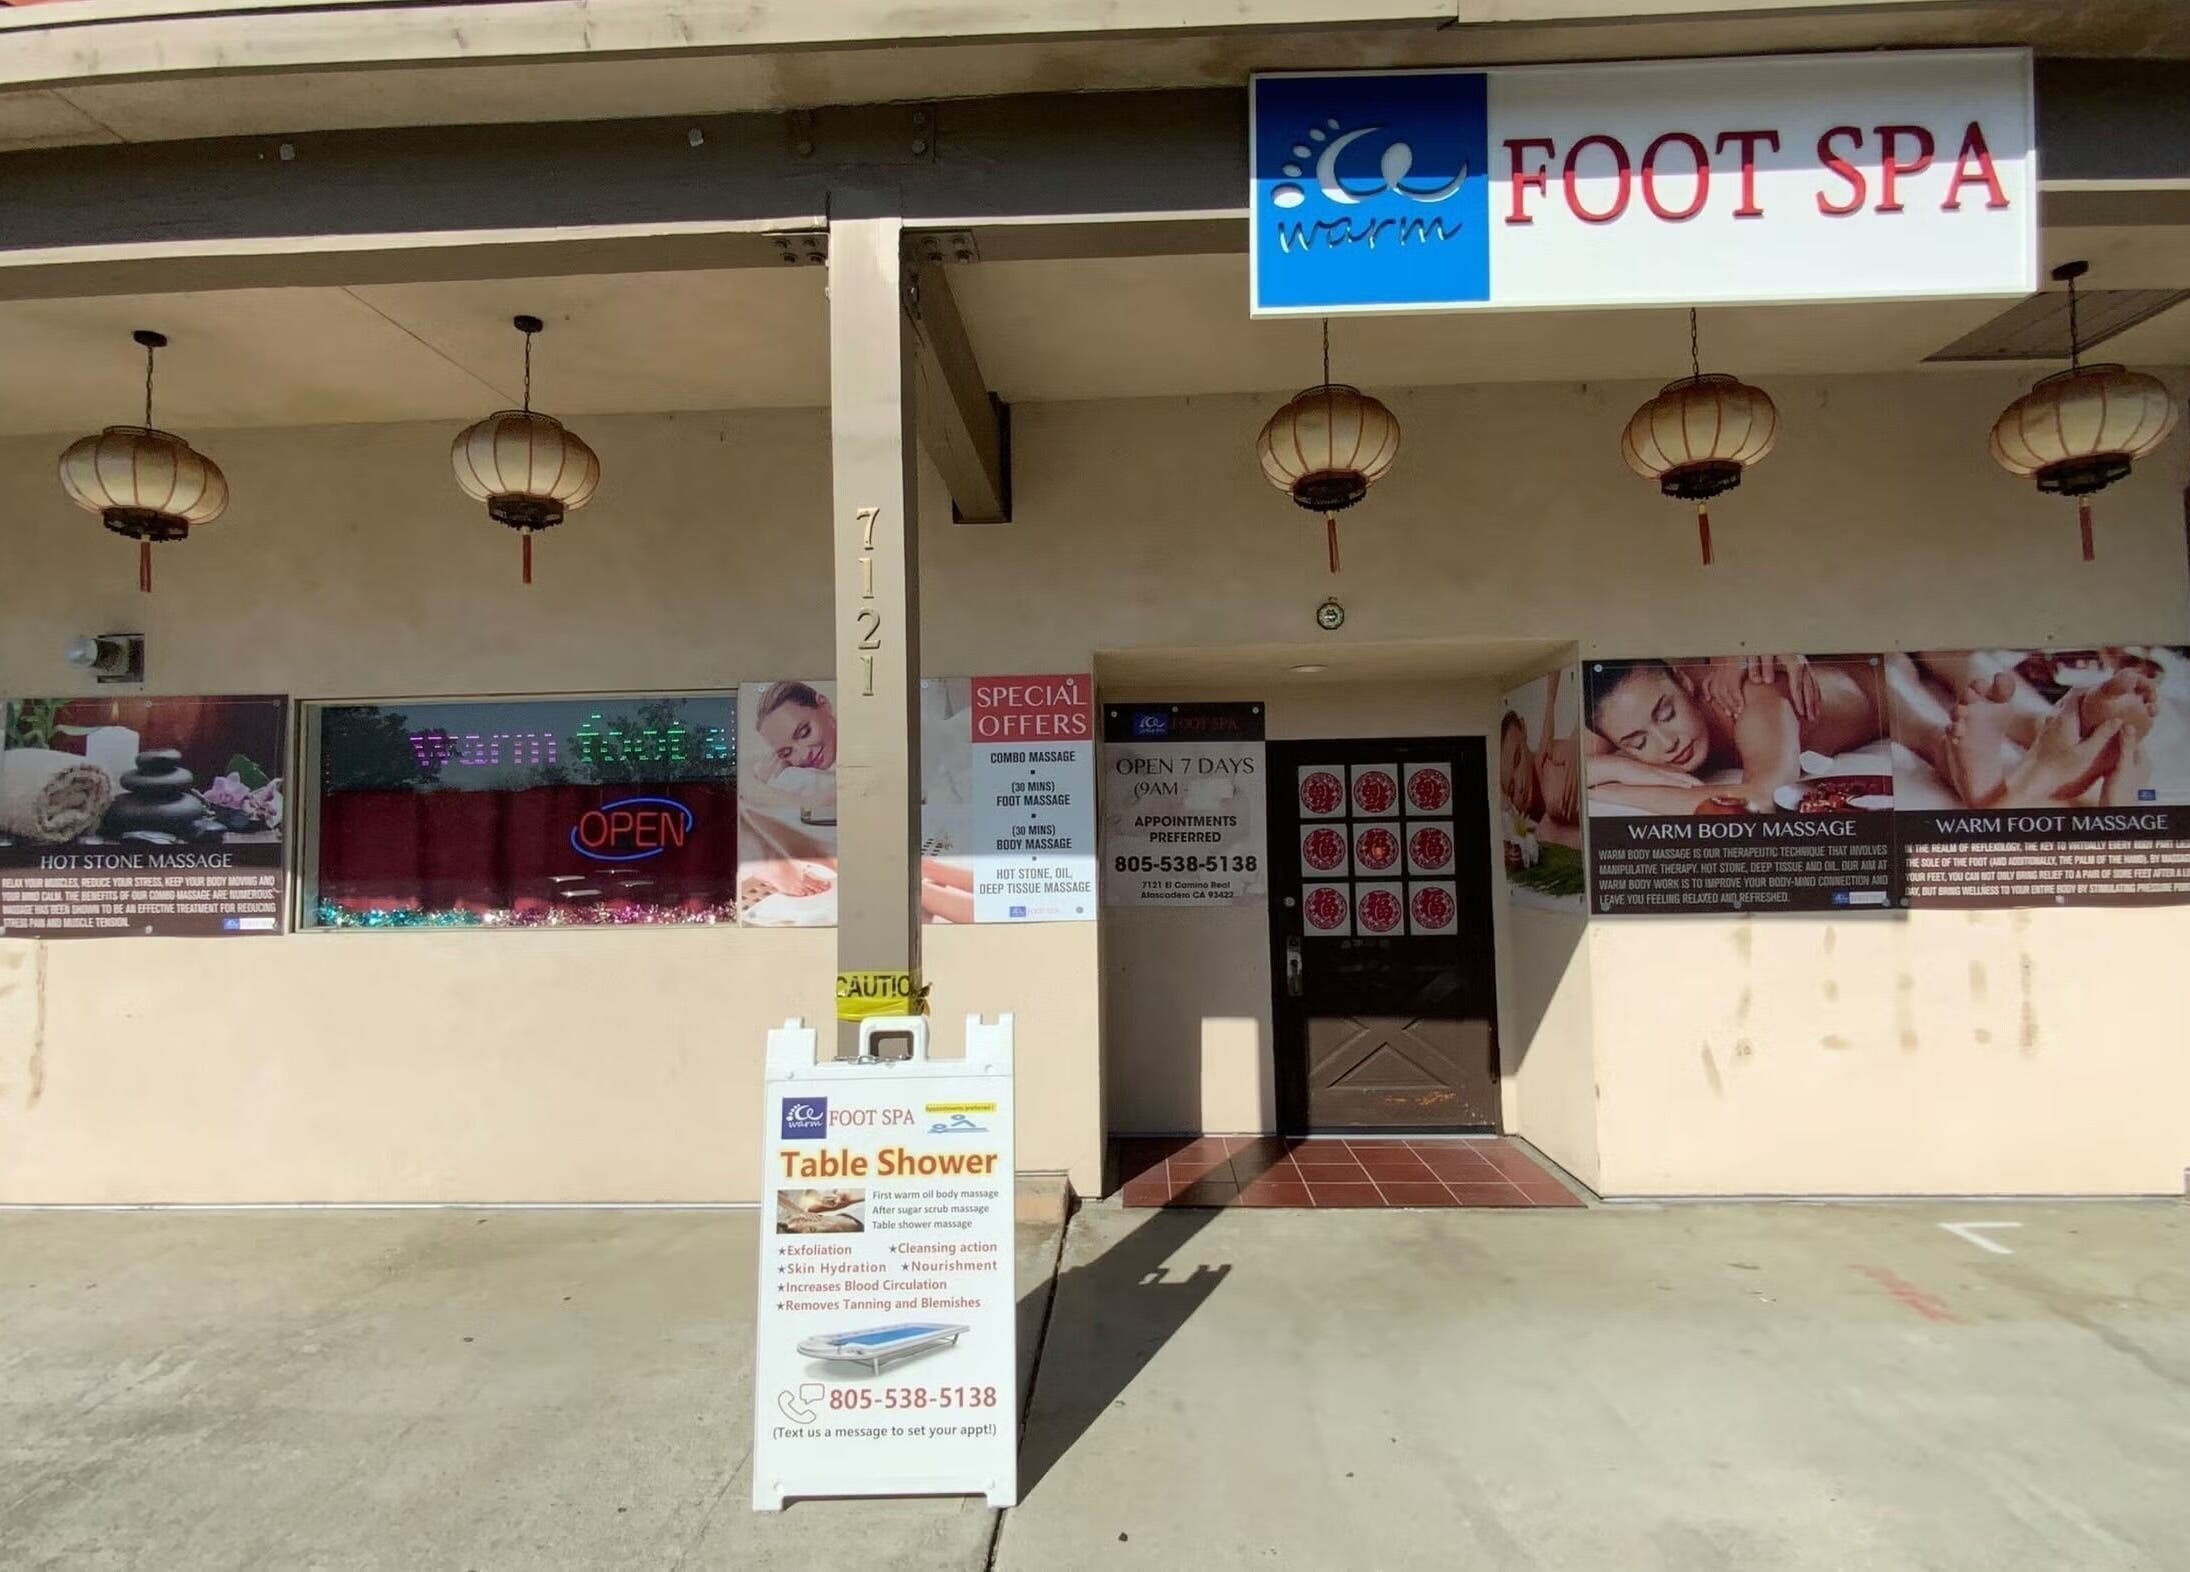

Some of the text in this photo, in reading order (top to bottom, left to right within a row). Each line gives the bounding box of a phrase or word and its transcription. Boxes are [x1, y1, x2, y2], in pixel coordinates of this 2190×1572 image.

[1503, 120, 2010, 225] FOOT SPA
[1278, 215, 1466, 254] warm
[855, 506, 882, 697] 7121
[976, 684, 1087, 708] SPECIAL
[978, 713, 1086, 737] OFFERS
[410, 734, 557, 767] warm
[577, 715, 686, 763] foot
[990, 751, 1076, 764] COMBO MASSAGE
[1116, 757, 1255, 775] OPEN 7 DAYS
[1011, 781, 1056, 793] (30 MINS)
[1134, 781, 1179, 798] (9AM
[996, 794, 1071, 807] FOOT MASSAGE
[1134, 815, 1238, 827] APPOINTMENTS
[1936, 815, 2169, 834] WARM FOOT MASSAGE
[579, 810, 685, 848] OPEN
[1012, 824, 1056, 836] (30 MINS)
[1628, 820, 1857, 840] WARM BODY MASSAGE
[996, 838, 1072, 851] BODY MASSAGE
[1150, 832, 1222, 843] PREFERRED
[1598, 849, 1626, 860] WARM
[1627, 849, 1650, 860] BODY
[1652, 848, 1691, 860] MASSAGE
[1693, 847, 1701, 858] IS
[1703, 847, 1721, 858] OUR
[1723, 847, 1778, 858] THERAPEUTIC
[1780, 846, 1827, 857] TECHNIQUE
[1828, 845, 1848, 856] THAT
[41, 853, 233, 870] HOT STONE MASSAGE
[1115, 855, 1258, 873] 805-538-5138
[1701, 863, 1717, 874] HOT
[1750, 862, 1772, 873] DEEP
[1775, 861, 1803, 872] TISSUE
[1805, 861, 1822, 872] AND
[1842, 860, 1859, 871] OUR
[996, 867, 1073, 880] HOT STONE, OIL,
[979, 882, 1091, 895] DEEP TISSUE MASSAGE
[1142, 881, 1162, 889] 7121
[1175, 881, 1207, 889] Camino
[1211, 880, 1231, 889] Real
[1599, 879, 1627, 890] WARM
[1629, 879, 1651, 890] BODY
[1655, 878, 1680, 889] WORK
[1682, 878, 1690, 889] IS
[1692, 878, 1703, 888] TO
[1744, 877, 1767, 888] YOUR
[1872, 875, 1888, 885] AND
[1194, 891, 1205, 899] CA
[1627, 894, 1644, 904] YOU
[1646, 893, 1680, 905] FEELING
[1683, 893, 1719, 904] RELAXED
[829, 1109, 915, 1126] FOOT SPA
[780, 1148, 998, 1178] Table Shower
[873, 1189, 1000, 1200] First warm oil body massage
[872, 1205, 989, 1216] After sugar scrub massage
[872, 1220, 973, 1230] Table shower massage
[787, 1242, 998, 1256] Exfoliation Cleansing action
[787, 1261, 998, 1276] Skin Hydration Nourishment
[786, 1280, 948, 1293] Increases Blood Circulation
[786, 1297, 981, 1312] Removes Tanning and Blemishes
[829, 1386, 998, 1410] 805-538-5138
[773, 1424, 997, 1440] (Text us a message to set your appt!)
